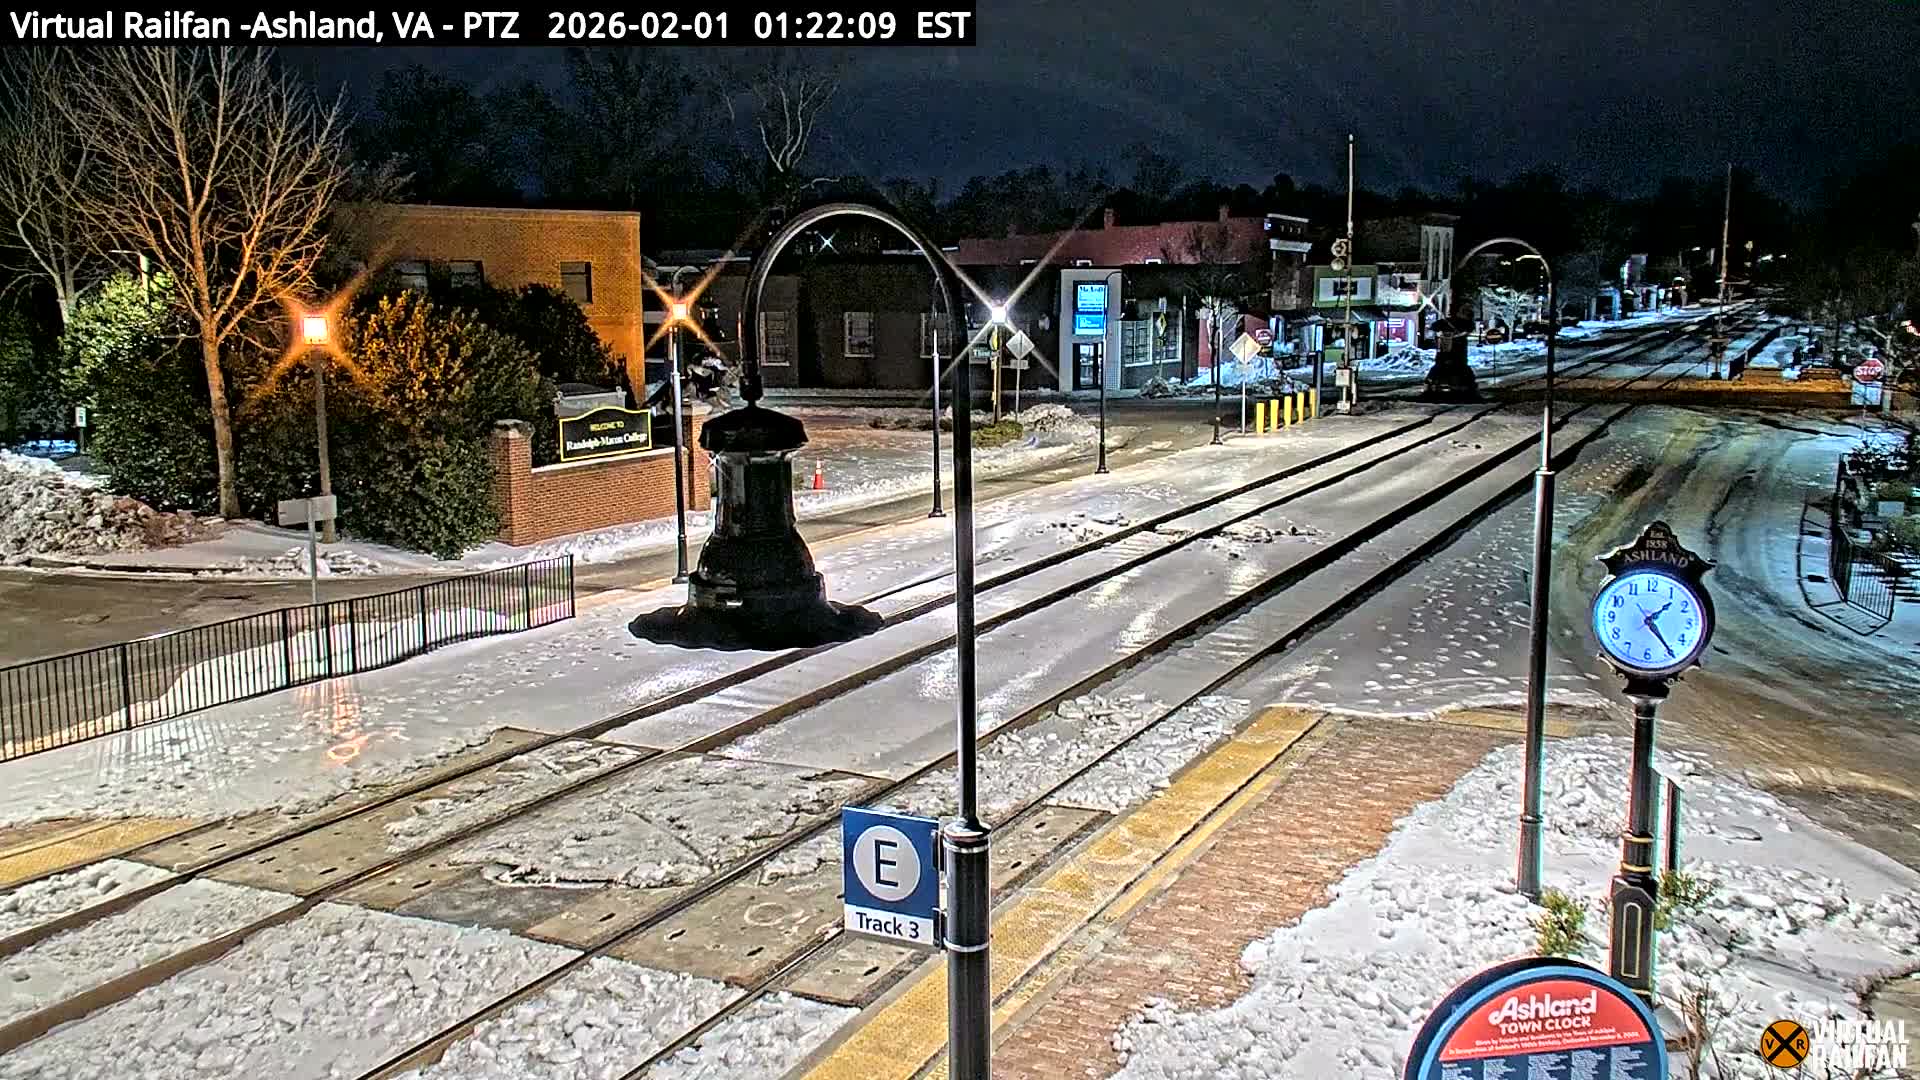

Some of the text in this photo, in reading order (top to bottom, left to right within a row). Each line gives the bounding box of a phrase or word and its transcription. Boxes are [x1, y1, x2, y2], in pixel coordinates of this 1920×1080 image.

[1855, 366, 1881, 376] STOP
[1624, 549, 1689, 568] ASHLAND
[1628, 583, 1639, 596] 11
[1647, 579, 1659, 593] 12
[1668, 586, 1674, 599] 1
[1612, 595, 1625, 609] 10
[1680, 600, 1689, 613] 2
[1607, 610, 1616, 623] 9
[1684, 617, 1694, 630] 3
[1611, 626, 1621, 640] 8
[1678, 633, 1687, 646] 4
[1623, 641, 1632, 655] 7
[1643, 647, 1652, 660] 6
[873, 838, 899, 888] E
[855, 910, 920, 940] Track 3
[1487, 989, 1598, 1026] Ashland
[1499, 1015, 1592, 1036] TOWN CLOCK
